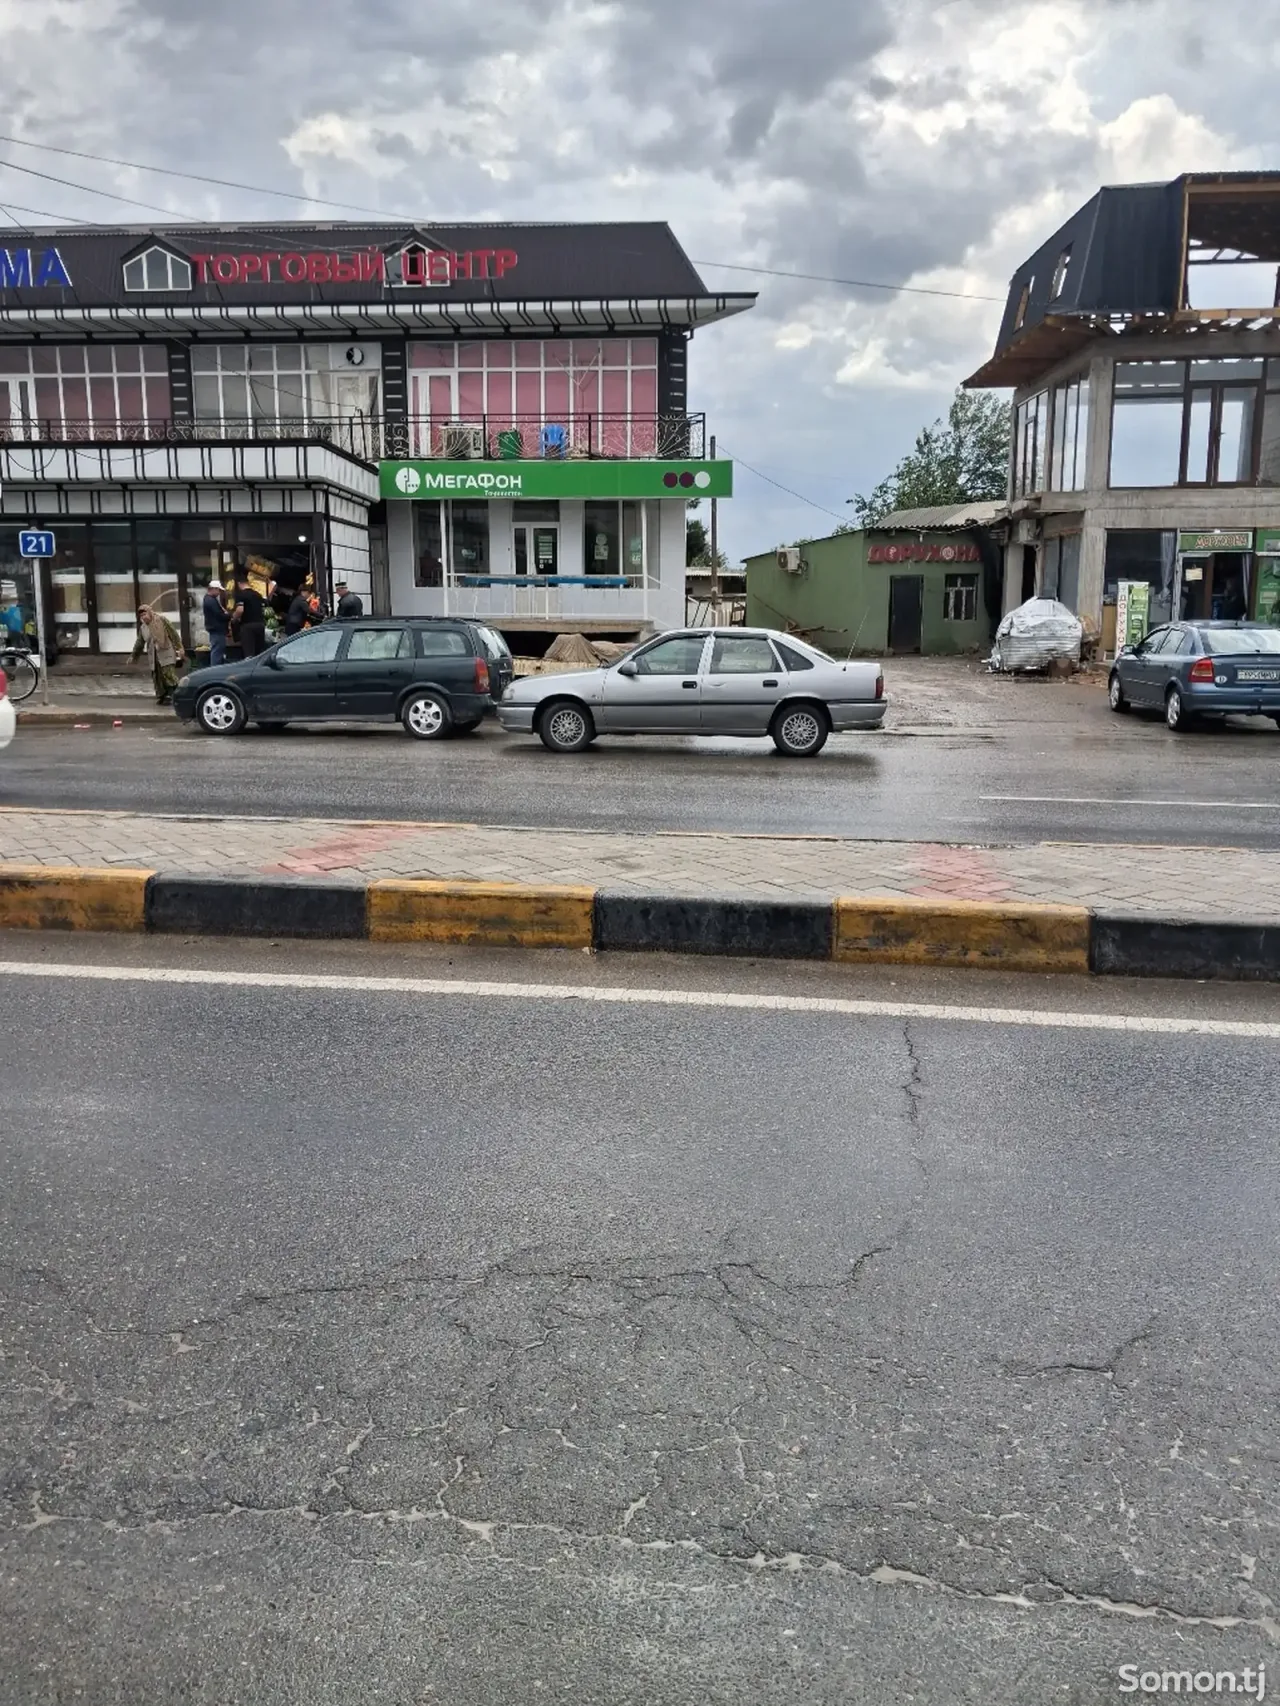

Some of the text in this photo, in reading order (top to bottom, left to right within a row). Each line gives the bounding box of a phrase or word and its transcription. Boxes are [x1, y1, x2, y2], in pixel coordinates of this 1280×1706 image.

[192, 246, 518, 287] ТОРГОВЫЙ ЦЕНТР
[426, 473, 522, 488] МЕГАФОН
[26, 536, 47, 553] 21
[868, 544, 983, 564] ДОРУХОНА
